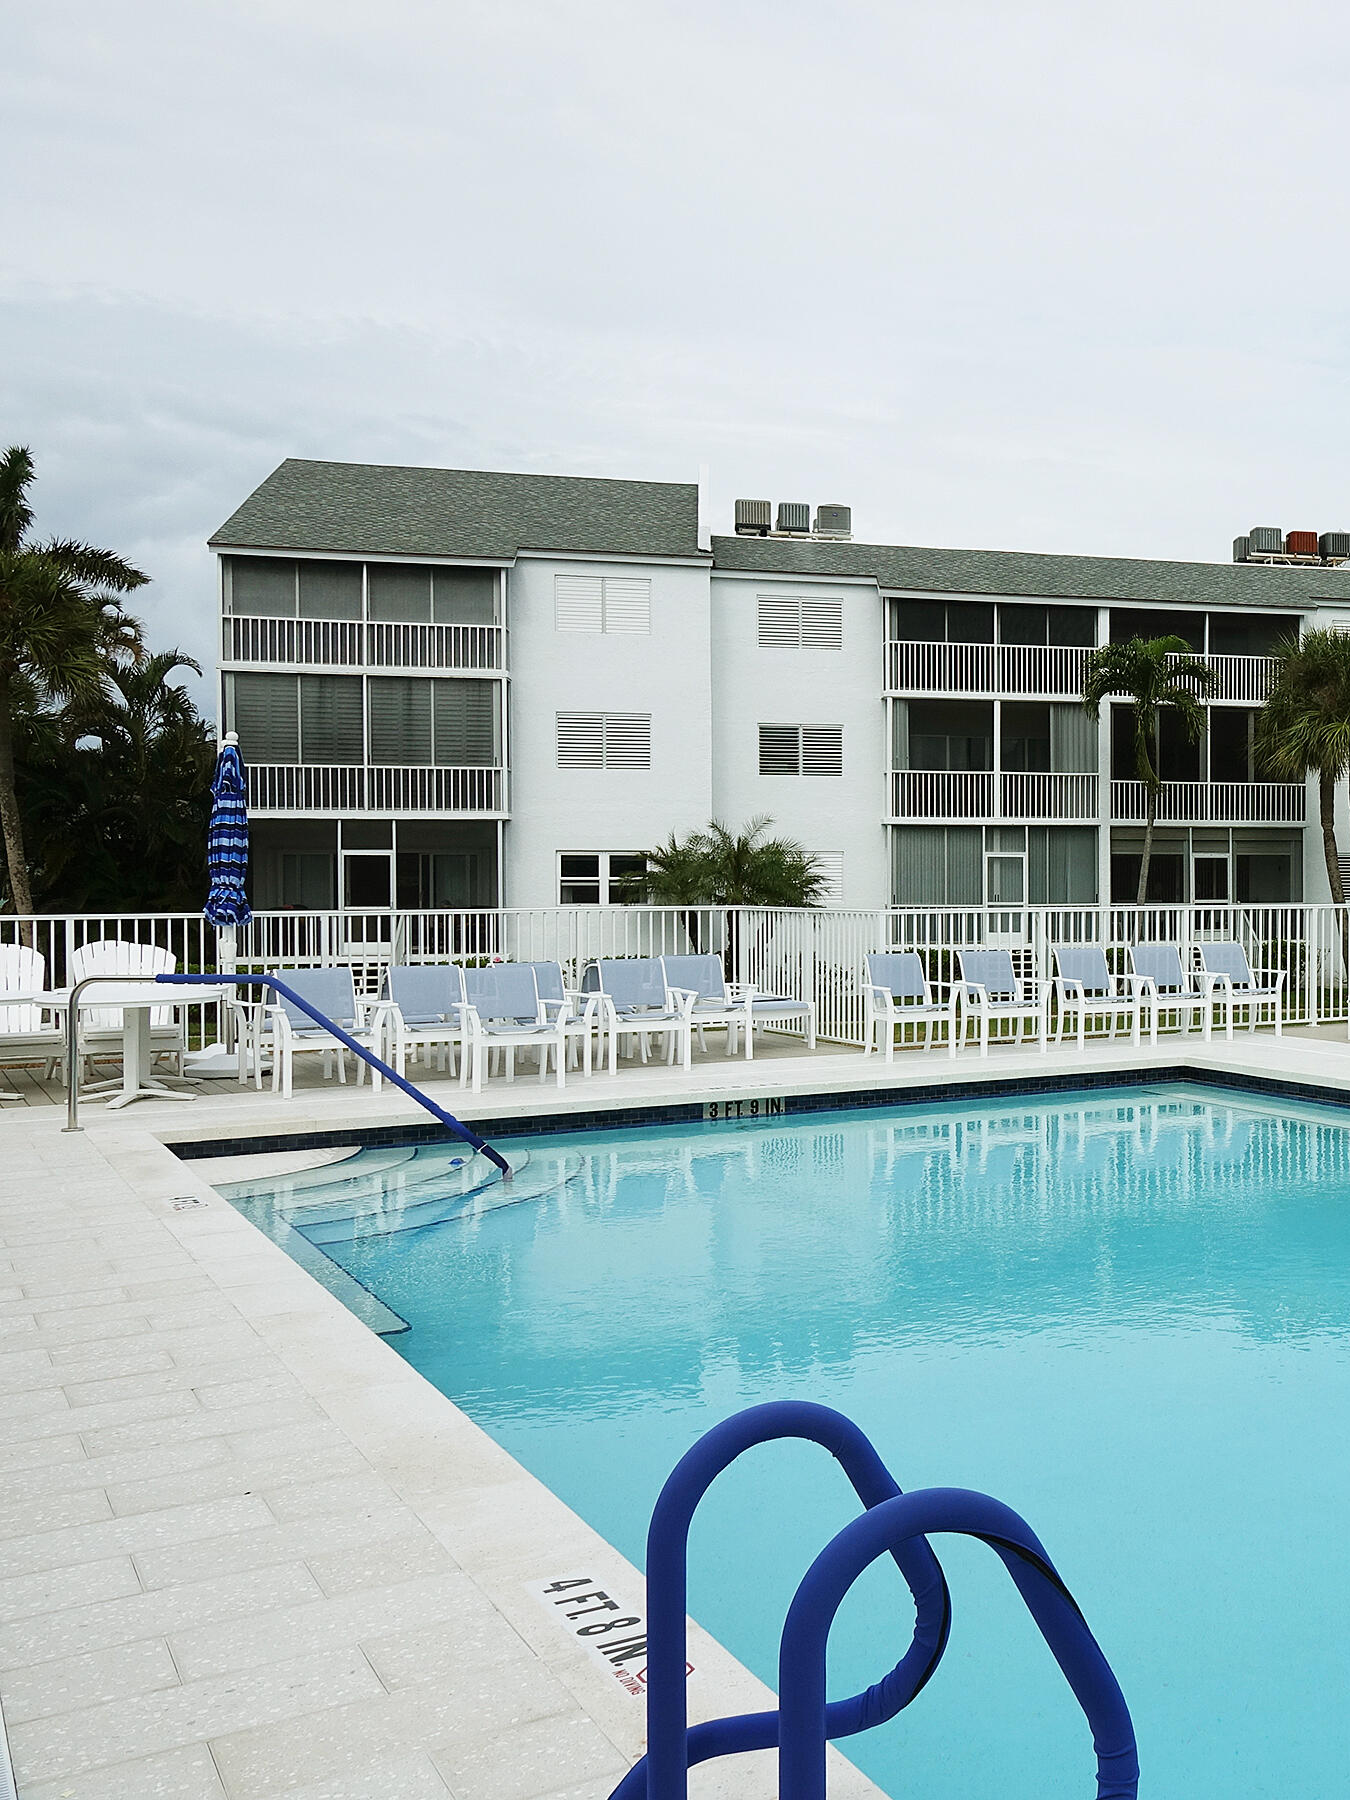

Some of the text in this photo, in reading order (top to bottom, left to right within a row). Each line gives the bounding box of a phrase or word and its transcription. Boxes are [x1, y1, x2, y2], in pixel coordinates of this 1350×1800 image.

[709, 1096, 784, 1118] 3 FT. 9 IN.
[543, 1578, 648, 1667] 4 FT. 8 IN.
[612, 1669, 646, 1696] NO DIVING
